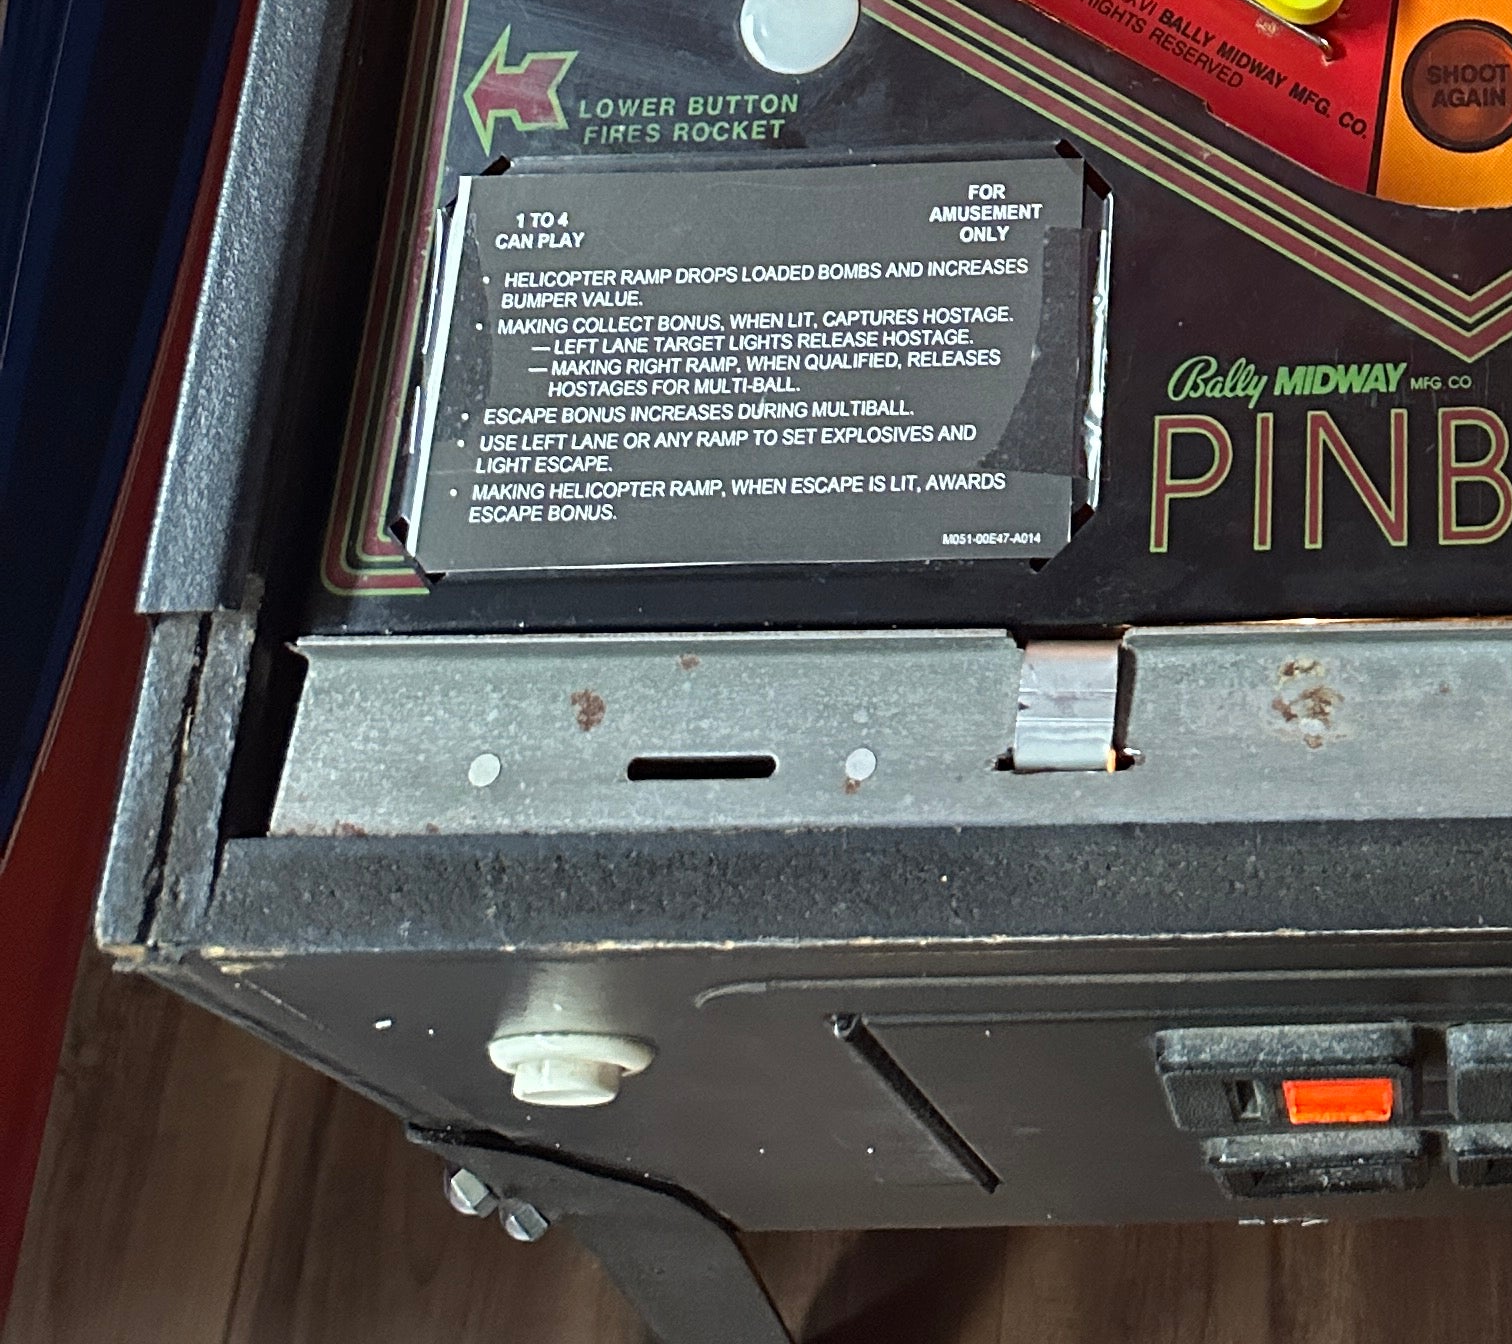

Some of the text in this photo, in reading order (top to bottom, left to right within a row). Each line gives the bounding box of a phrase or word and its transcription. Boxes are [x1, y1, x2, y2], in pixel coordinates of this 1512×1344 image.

[1149, 27, 1244, 89] RESERVED
[1158, 8, 1216, 48] BALLY
[1216, 40, 1289, 90] MIDWAY
[1288, 78, 1331, 120] MFG.
[1338, 110, 1368, 140] CO.
[1426, 63, 1510, 85] SHOOT
[578, 92, 799, 121] LOWER BUTTON
[1431, 87, 1506, 109] AGAIN
[582, 118, 786, 146] FIRES ROCKET
[966, 182, 1006, 201] FOR
[515, 210, 569, 229] 1 TO 4
[927, 202, 1044, 223] AMUSEMENT
[493, 230, 585, 250] CAN PLAY
[958, 224, 1010, 243] ONLY
[503, 256, 1029, 288] HELICOPTER RAMP DROPS LOADED BOMBS AND INCREASES
[499, 289, 644, 309] BUMPER VALUE.
[546, 375, 801, 398] HOSTAGES FOR MULTI-BALL.
[1167, 355, 1268, 409] Bally
[1273, 362, 1408, 396] MIDWAY
